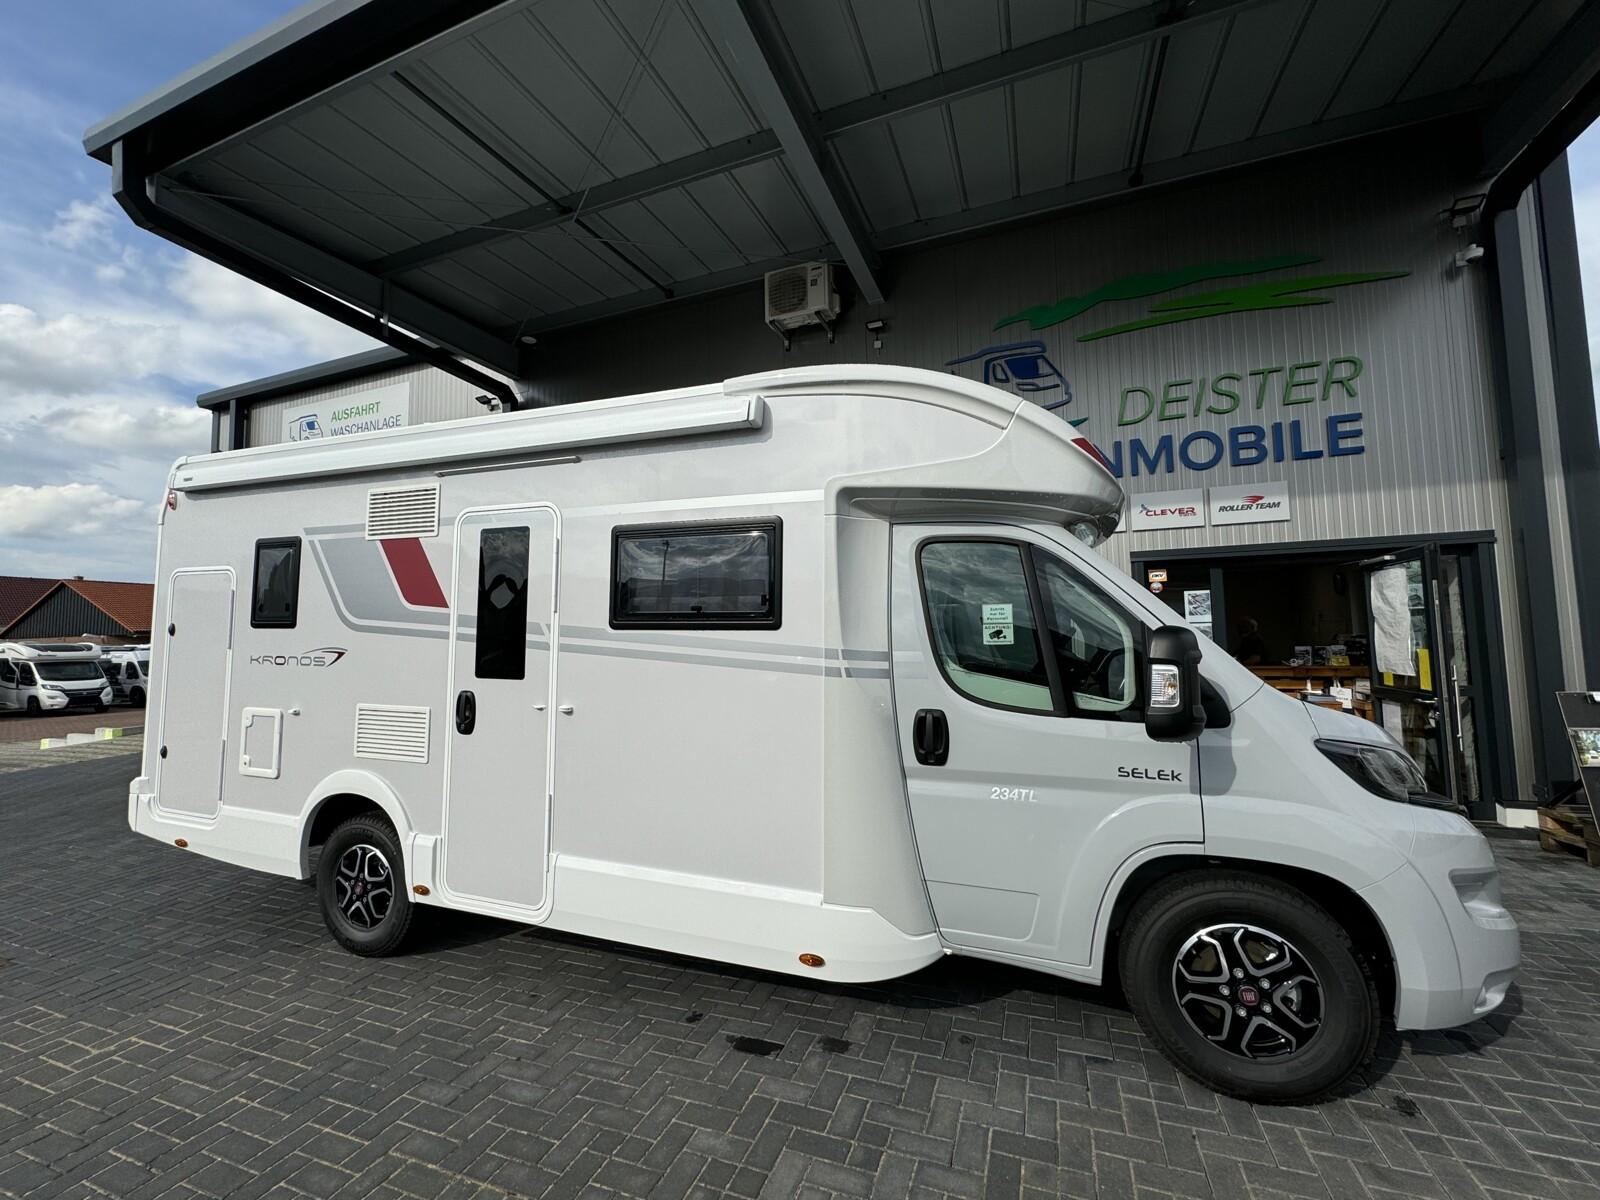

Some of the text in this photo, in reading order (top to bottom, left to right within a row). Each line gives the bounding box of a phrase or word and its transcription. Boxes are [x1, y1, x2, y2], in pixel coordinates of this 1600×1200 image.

[1118, 356, 1363, 426] DEISTER
[331, 401, 380, 422] AUSFAHRT
[331, 414, 401, 437] WASCHANLAGE
[1145, 506, 1195, 517] CLEVER
[1218, 501, 1281, 513] ROLLER TEAM
[249, 655, 326, 667] KRONOS
[1118, 766, 1182, 782] SELEK
[990, 786, 1037, 802] 234TL
